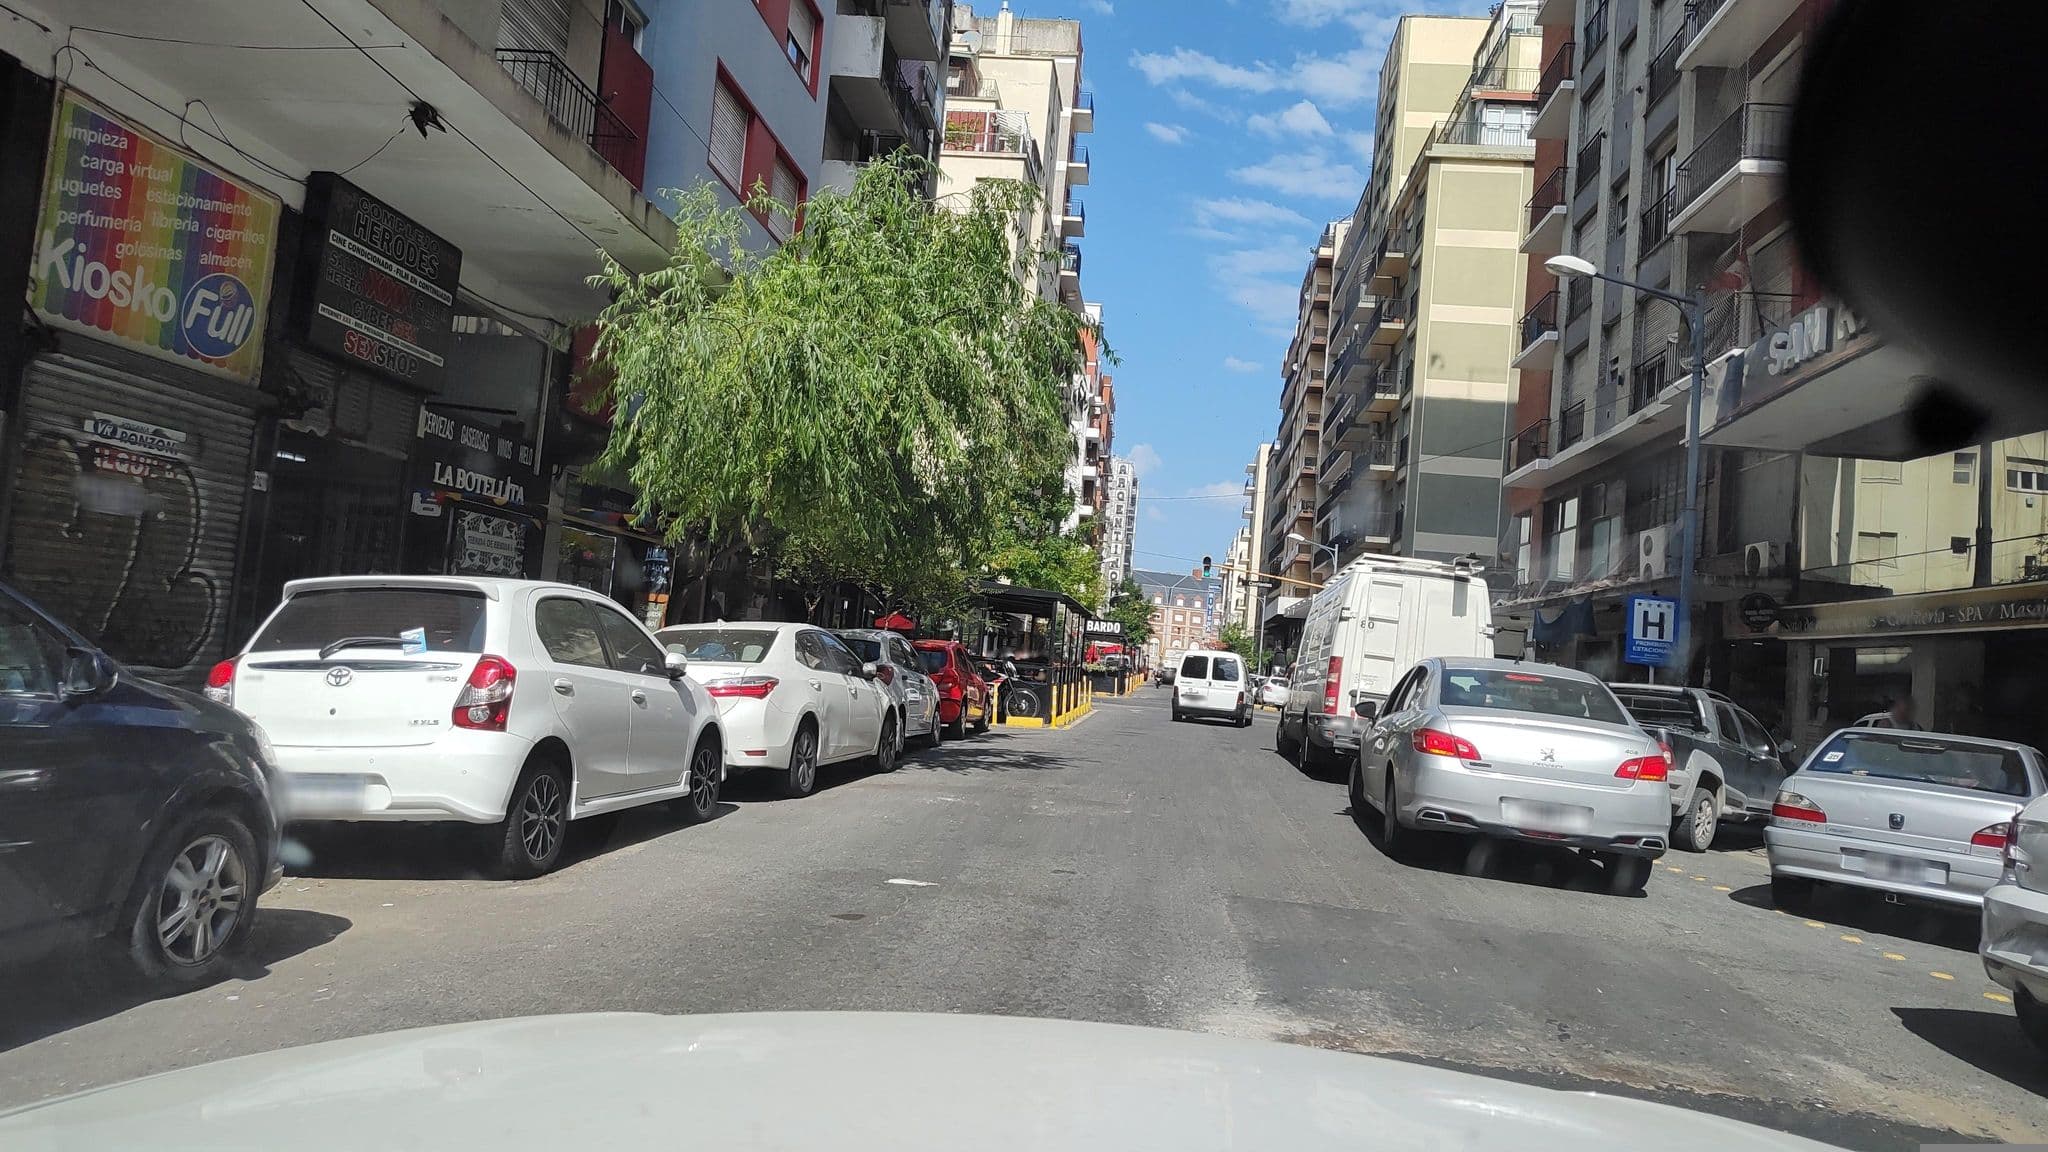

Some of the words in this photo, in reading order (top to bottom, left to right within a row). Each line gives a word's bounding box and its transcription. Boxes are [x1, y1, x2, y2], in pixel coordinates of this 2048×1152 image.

[64, 122, 128, 149] limpieza
[80, 155, 125, 176] carga
[129, 162, 174, 183] virtual
[52, 174, 122, 199] juguetes
[146, 187, 252, 217] estacionamiento
[56, 209, 142, 233] perfumería
[205, 224, 266, 245] cigarrillos
[358, 197, 441, 253] COMPLEJO
[115, 240, 183, 261] golosinas
[331, 233, 348, 247] CINE
[347, 239, 393, 272] CONDICIONADO
[395, 267, 410, 282] FILM
[410, 274, 418, 286] EN
[353, 211, 440, 280] HERODES
[38, 229, 177, 323] Kiosko
[185, 288, 253, 346] Full
[422, 409, 455, 441] CERVEZAS
[460, 425, 490, 453] GASEOSAS
[433, 461, 453, 487] LA
[454, 468, 525, 505] BOTELLITA
[1109, 464, 1128, 580] ARGENTINO
[1086, 620, 1121, 634] BARDO
[1360, 619, 1375, 630] 80
[1642, 610, 1665, 640] H
[1958, 606, 1984, 623] SPA
